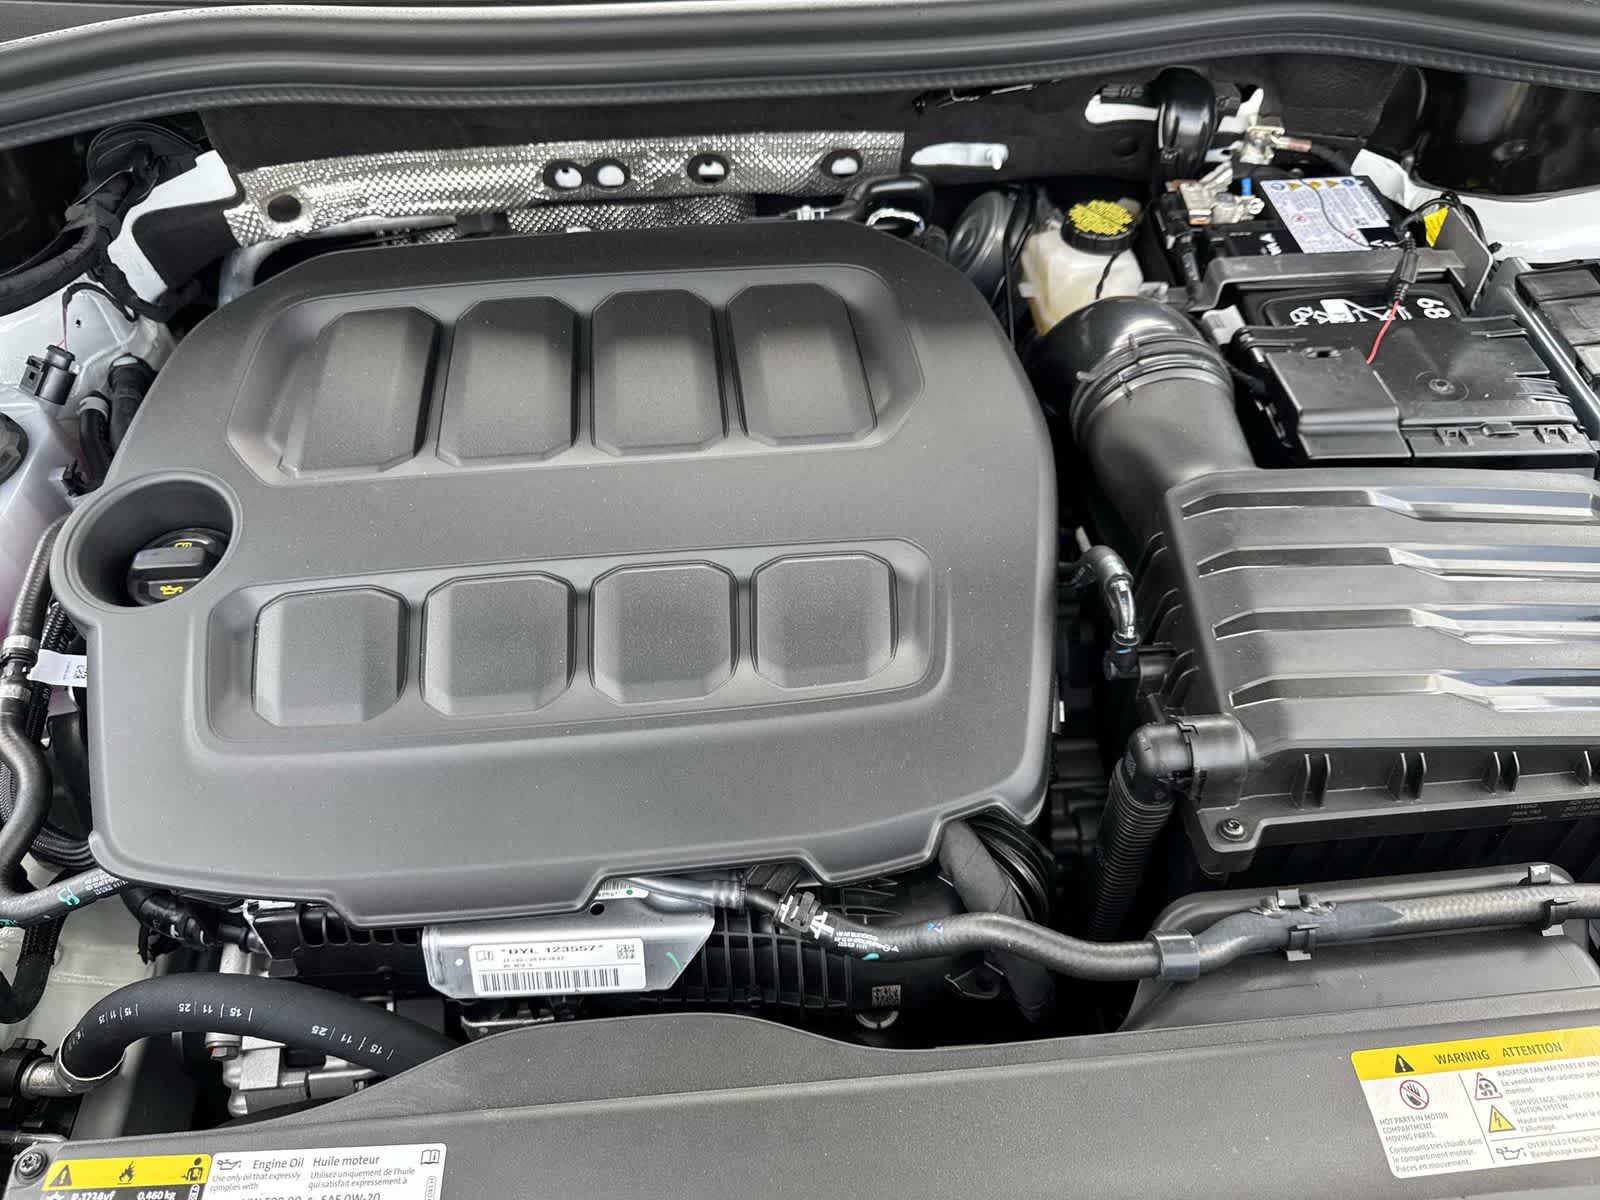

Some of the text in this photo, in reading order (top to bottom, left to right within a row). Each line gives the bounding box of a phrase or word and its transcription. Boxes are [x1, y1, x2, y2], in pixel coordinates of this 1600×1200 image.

[178, 1003, 192, 1013] 25
[311, 1024, 329, 1037] 25
[369, 1043, 383, 1055] 15
[1433, 1041, 1563, 1065] WARNING ATTENTION
[252, 1157, 305, 1172] Engine Oil
[313, 1155, 380, 1167] Huile moteur
[226, 1174, 242, 1183] only
[253, 1172, 267, 1181] that
[268, 1171, 301, 1181] expressly
